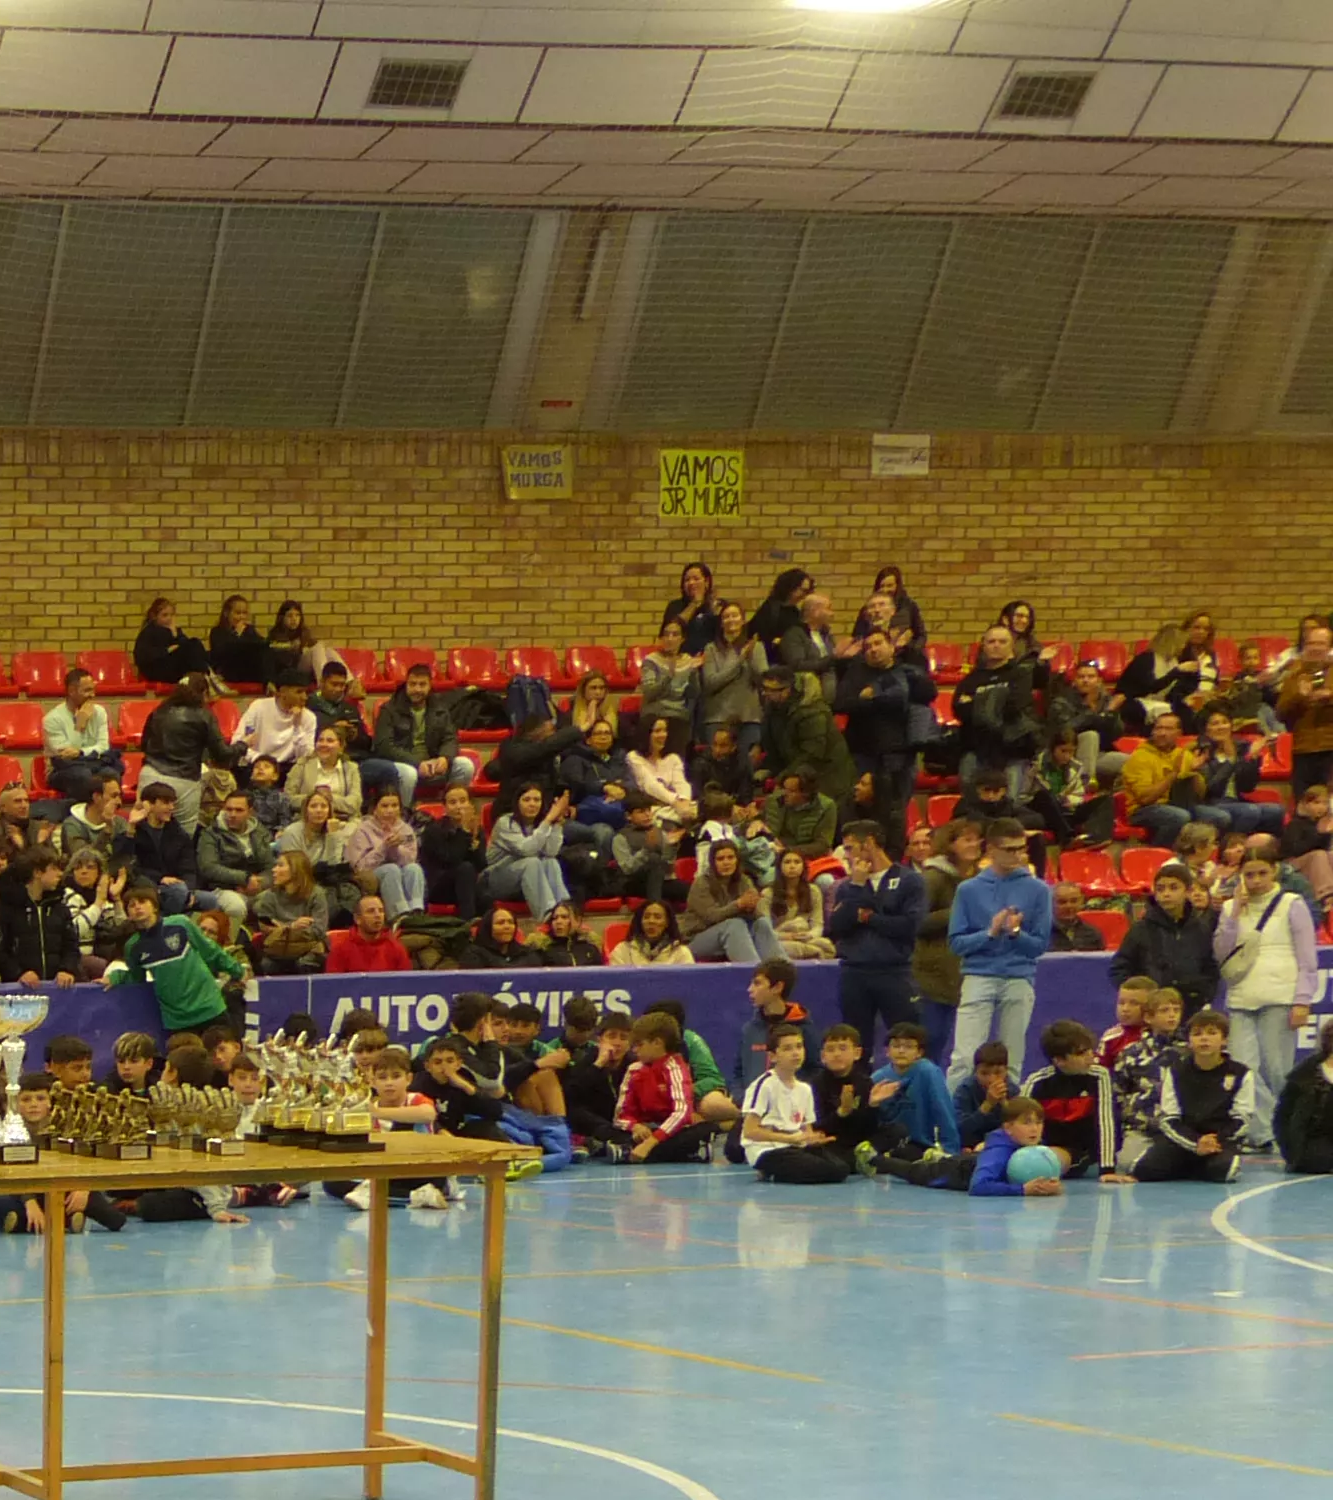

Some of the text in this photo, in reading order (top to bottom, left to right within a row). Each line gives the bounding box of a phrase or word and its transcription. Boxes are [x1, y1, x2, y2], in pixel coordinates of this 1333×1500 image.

[509, 450, 562, 468] VAMOS
[662, 454, 740, 486] VAMOS
[510, 472, 564, 488] MURGA
[662, 487, 740, 516] JR. MURGA
